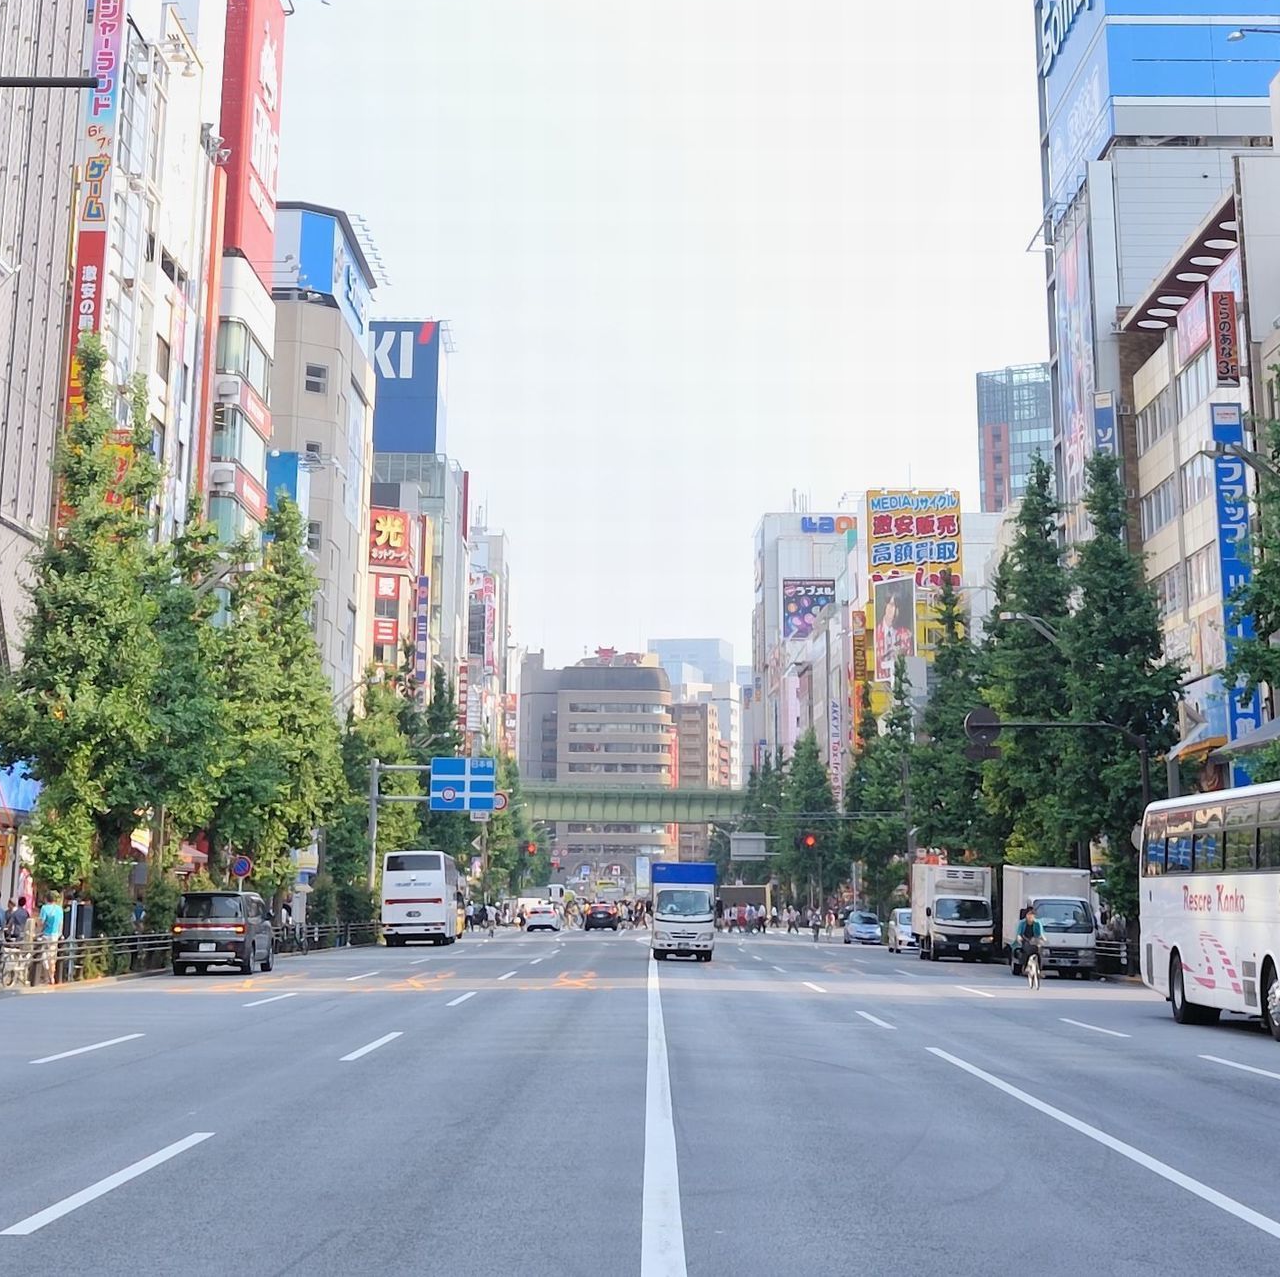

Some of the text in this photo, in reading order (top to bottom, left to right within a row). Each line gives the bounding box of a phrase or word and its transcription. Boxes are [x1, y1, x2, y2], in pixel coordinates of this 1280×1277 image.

[82, 153, 111, 222] ゲーム
[79, 264, 98, 337] 激安の殿
[1217, 293, 1235, 360] とらのあな
[871, 494, 957, 511] MEDIAリサイクル
[375, 513, 405, 548] 光
[370, 548, 409, 562] ネットワーク
[872, 540, 957, 564] 高額買取
[1182, 883, 1246, 913] Rescre Kanko
